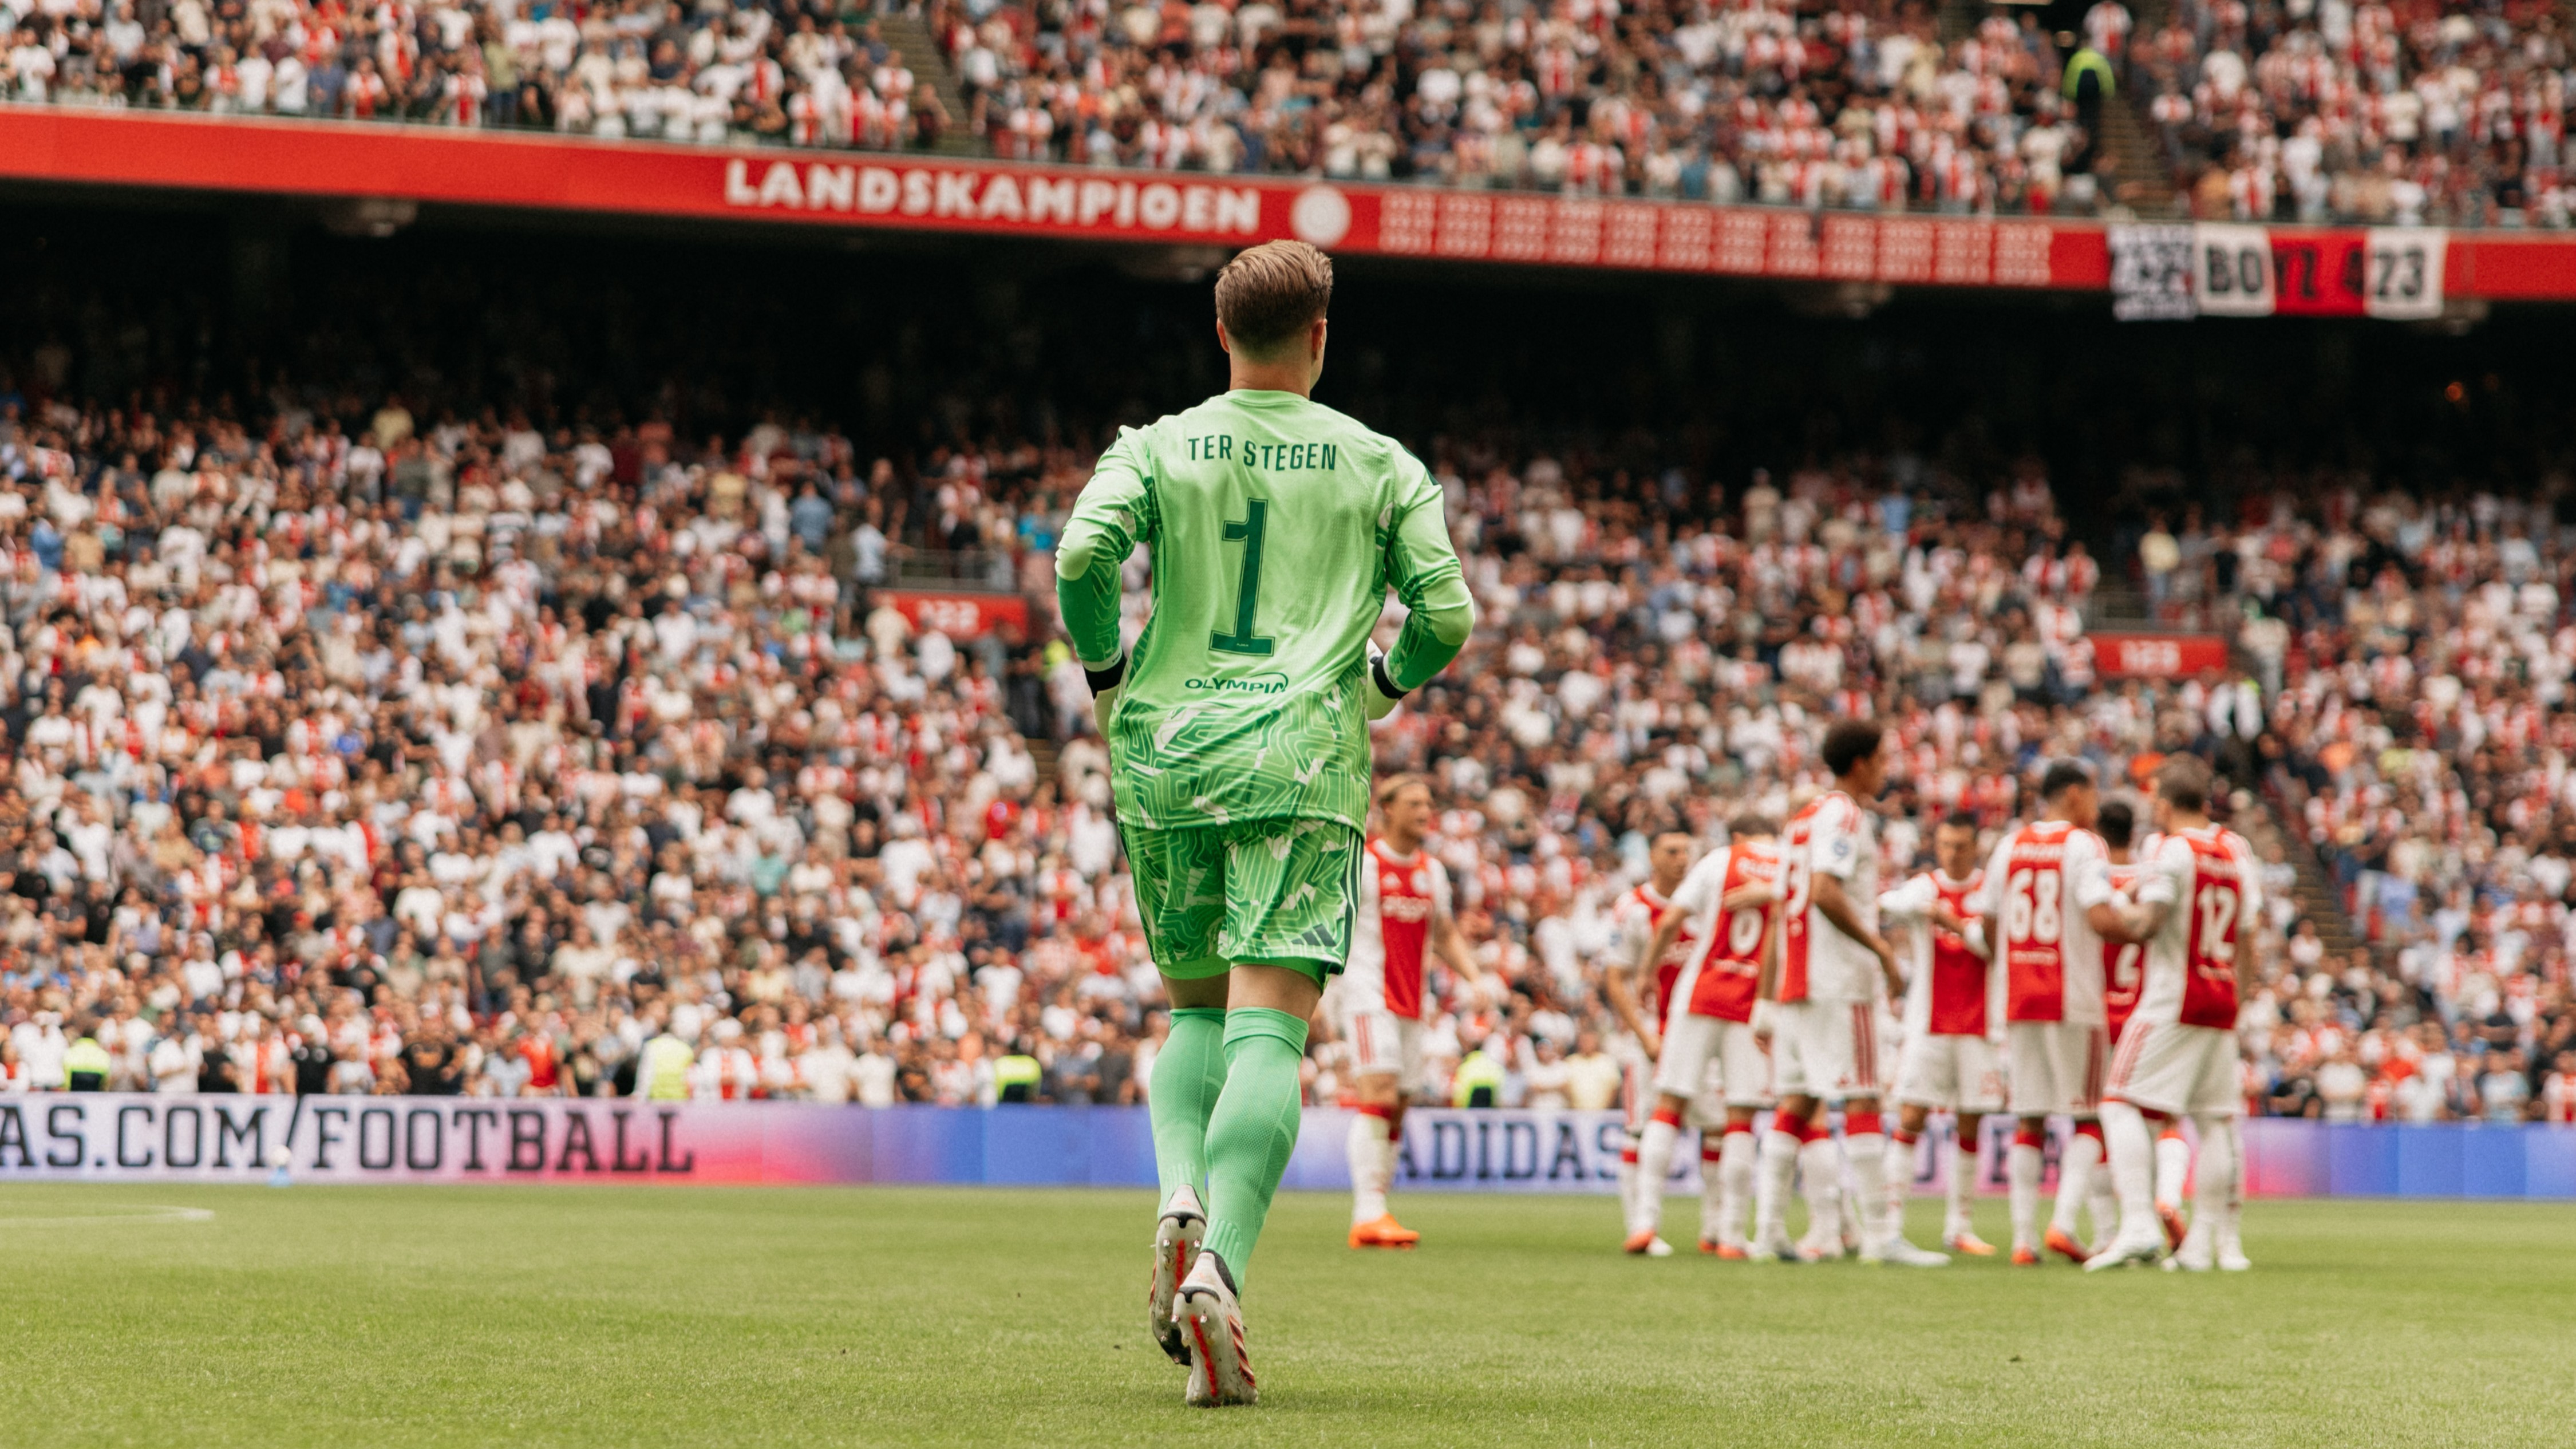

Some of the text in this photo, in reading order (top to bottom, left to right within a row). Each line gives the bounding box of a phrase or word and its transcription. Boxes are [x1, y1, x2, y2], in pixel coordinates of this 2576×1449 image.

[725, 159, 1259, 234] LANDSKAMPIOEN
[1188, 435, 1337, 471] TER STEGEN
[1208, 497, 1275, 657] 1
[1185, 673, 1289, 694] OLYMPIA
[2008, 867, 2061, 945] 68
[2197, 882, 2238, 960] 12
